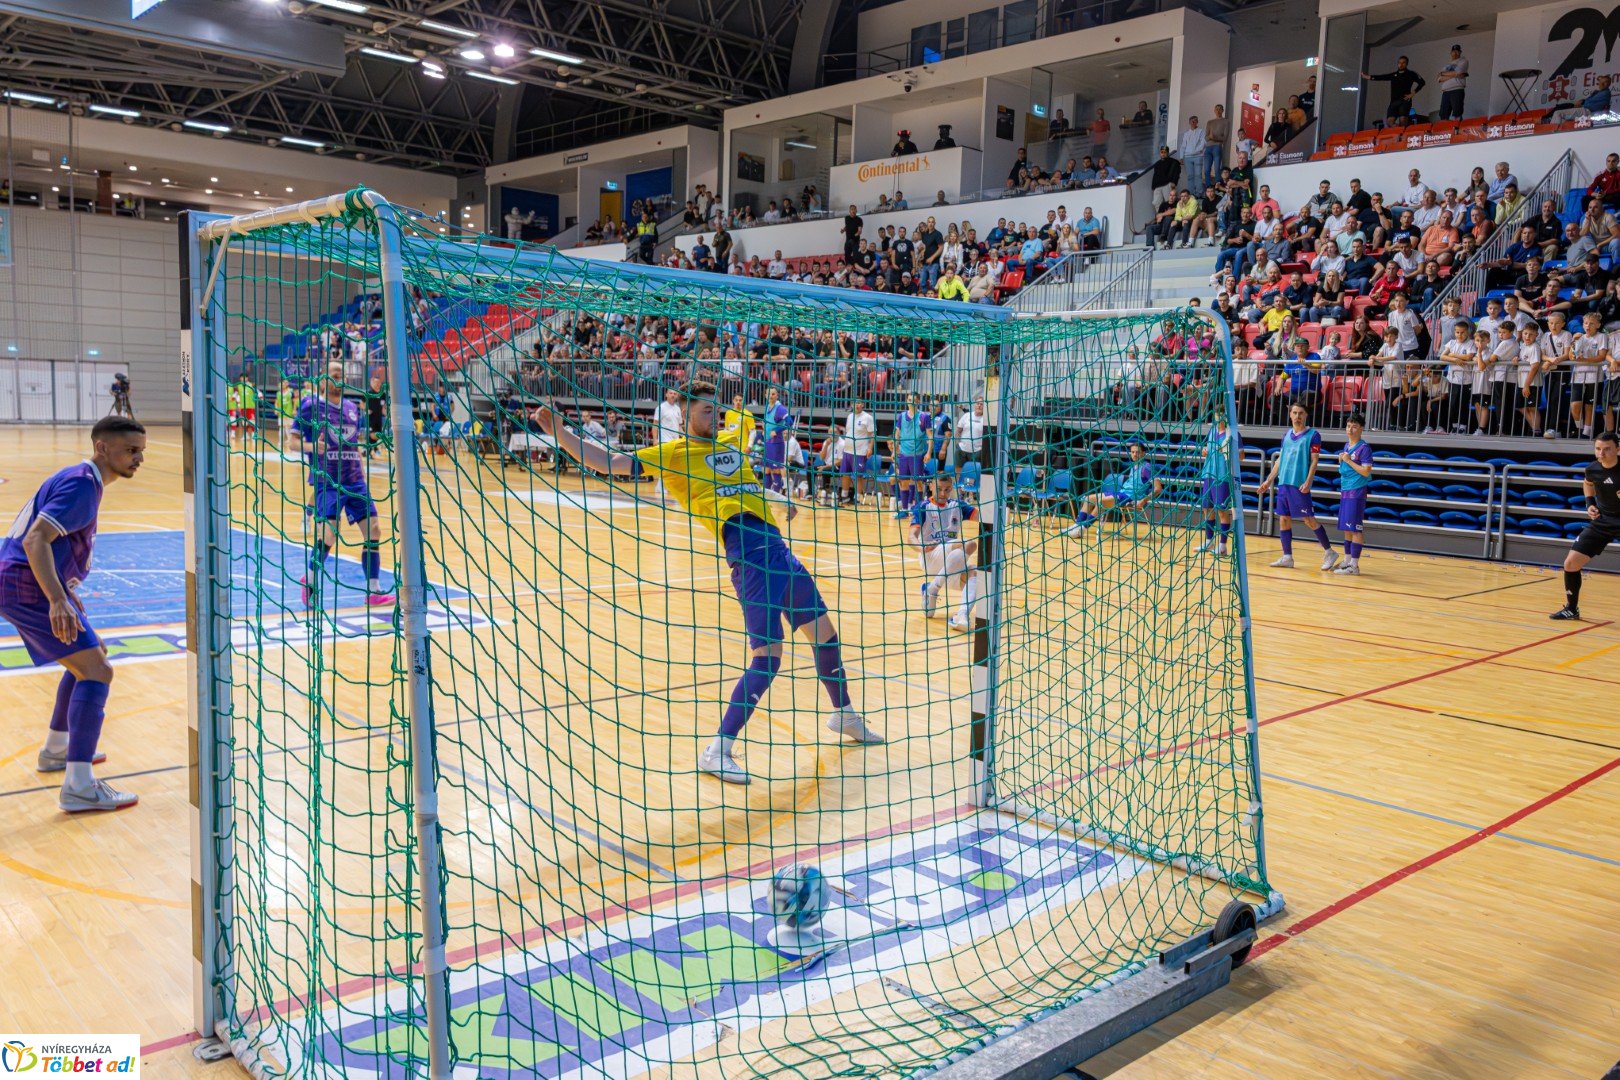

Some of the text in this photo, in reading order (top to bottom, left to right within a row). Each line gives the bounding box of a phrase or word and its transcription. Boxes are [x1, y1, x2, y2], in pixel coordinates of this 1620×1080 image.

[1504, 123, 1535, 131] Eissmann
[1423, 133, 1452, 141] Eissmann
[1279, 151, 1304, 159] Eissmann
[858, 157, 920, 182] Continental
[714, 455, 735, 466] MOL
